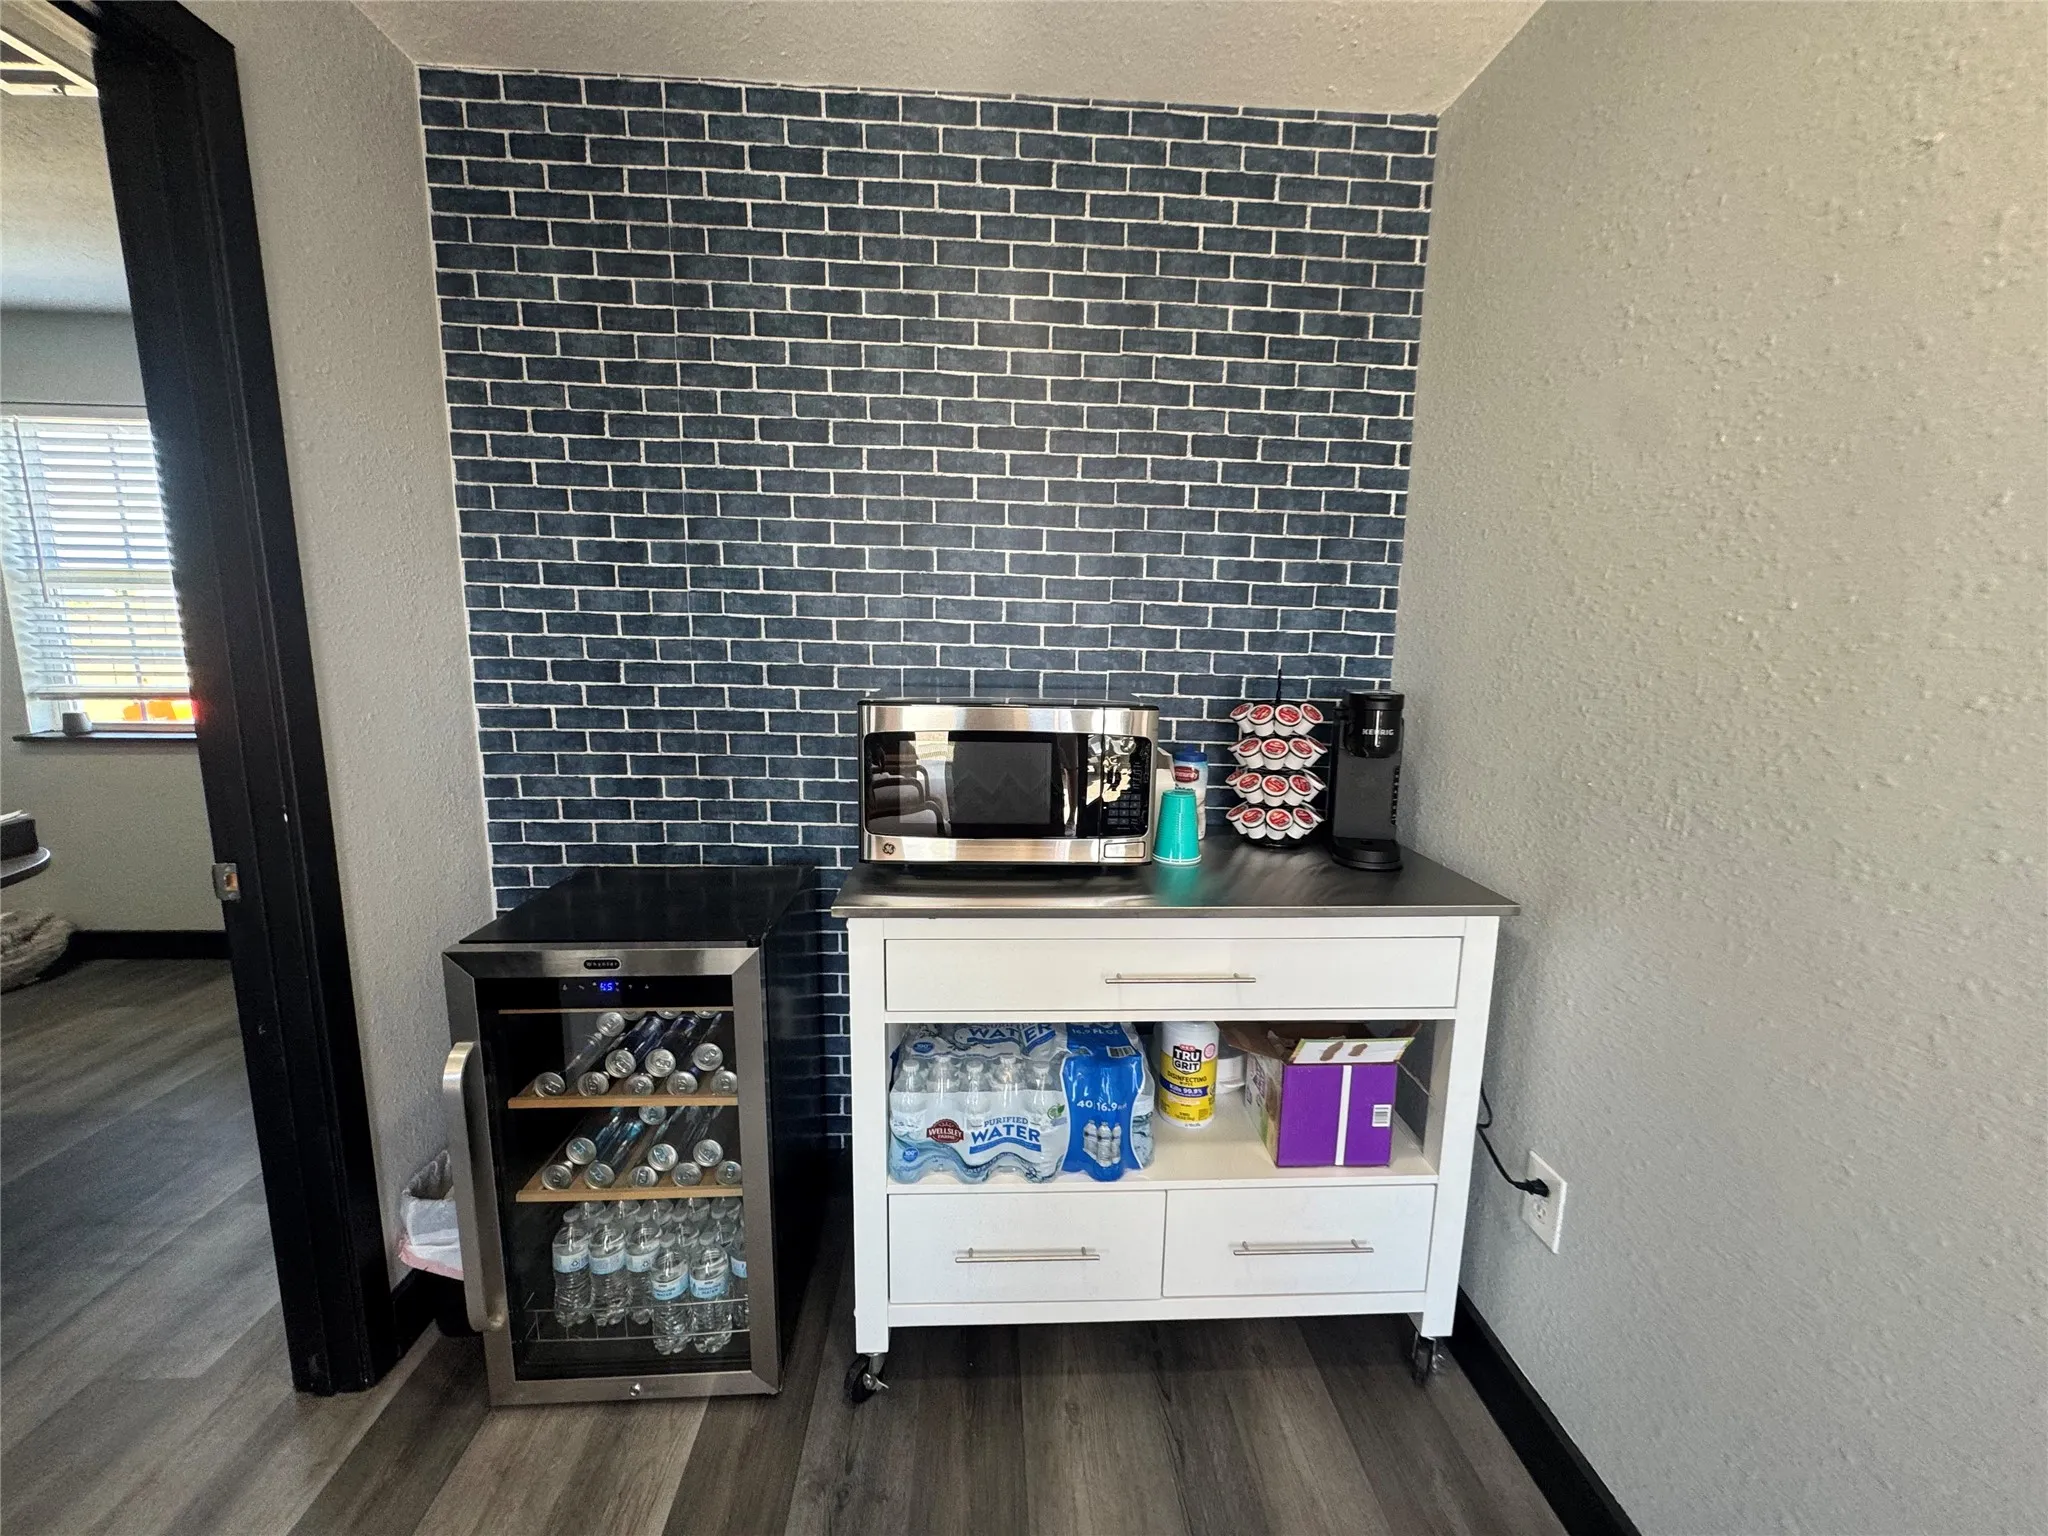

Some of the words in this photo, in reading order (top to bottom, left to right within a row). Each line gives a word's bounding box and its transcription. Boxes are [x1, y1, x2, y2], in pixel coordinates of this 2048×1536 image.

[1174, 1049, 1200, 1062] TRU
[1174, 1060, 1199, 1071] GRIT
[1076, 1100, 1093, 1108] 40
[1096, 1102, 1118, 1112] 16.9
[984, 1116, 1028, 1128] PURIFIED
[928, 1127, 963, 1137] WELLSLEY
[971, 1124, 1041, 1144] WATER
